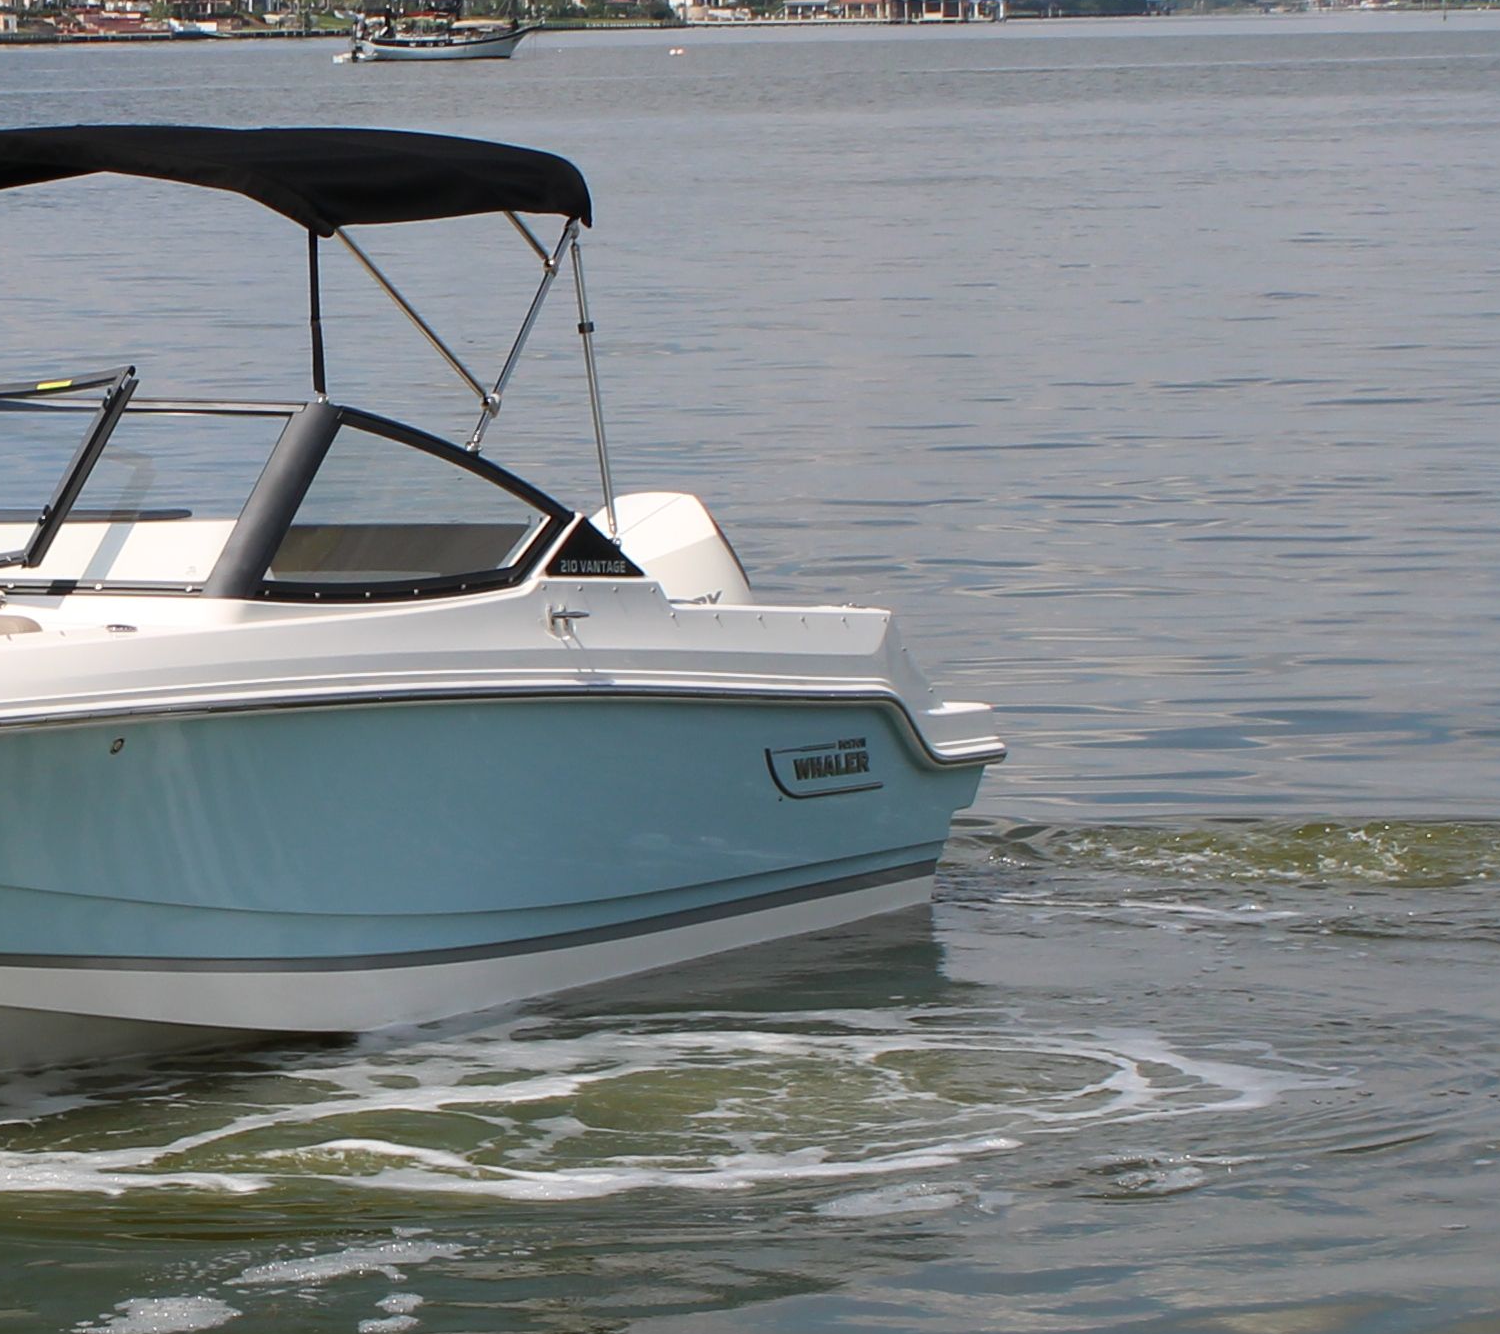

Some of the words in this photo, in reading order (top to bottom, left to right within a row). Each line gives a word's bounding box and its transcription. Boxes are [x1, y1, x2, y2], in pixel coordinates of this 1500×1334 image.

[560, 560, 578, 573] 210
[580, 560, 626, 573] VANTAGE
[793, 750, 870, 781] WHALER
